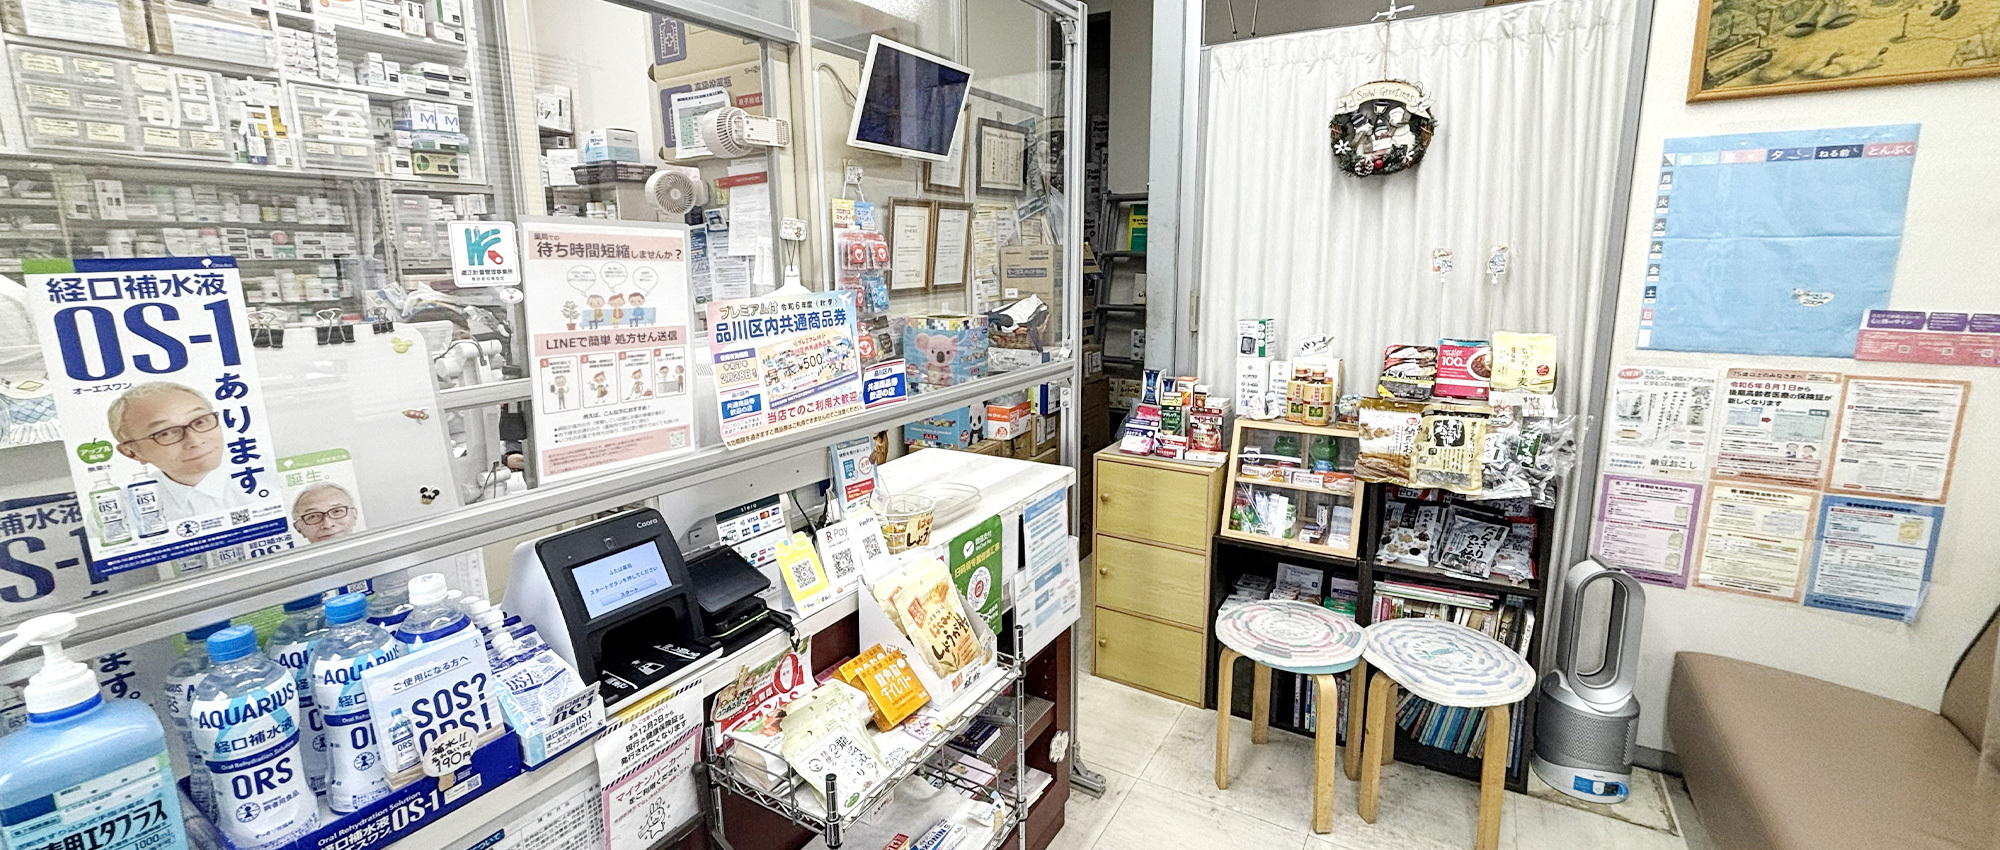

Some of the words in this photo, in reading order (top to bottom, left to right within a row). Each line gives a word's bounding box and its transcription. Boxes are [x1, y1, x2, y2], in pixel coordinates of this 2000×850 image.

[1380, 87, 1415, 101] Greetings
[1819, 149, 1849, 159] ねる前
[1661, 174, 1672, 184] 月
[1658, 198, 1668, 208] 火
[1655, 221, 1665, 230] 水
[533, 233, 559, 241] 薬局での
[536, 241, 682, 260] 待ち時間短縮しませんか?
[1652, 244, 1662, 253] 木
[1649, 267, 1659, 276] 金
[46, 272, 228, 303] 経口補水液
[1646, 288, 1656, 297] 土
[720, 301, 779, 319] プレミアム付
[715, 308, 847, 343] 品川区内共通商品券
[54, 298, 242, 381] OS-1
[546, 335, 611, 350] LINEで簡単
[615, 330, 678, 345] 処方せん送信
[874, 368, 893, 377] 品川区内
[1732, 371, 1803, 379] 75歳以上のみなさまへ
[72, 381, 132, 395] オーエスワン
[867, 378, 899, 391] 共通商品券
[1730, 381, 1812, 392] 令和6年8月1日から
[870, 389, 896, 400] 歓迎の店
[1727, 397, 1783, 407] 新しくなります
[1729, 389, 1832, 401] 後期高齢者医療の保険証が
[214, 373, 270, 498] あります。
[1650, 458, 1697, 469] 納豆おこし
[285, 469, 330, 487] 誕生。
[747, 515, 759, 523] VISA
[859, 517, 875, 527] PayPay
[834, 527, 848, 538] Pay
[250, 534, 292, 550] 経口補水液
[609, 563, 633, 575] ふたば薬局
[590, 566, 658, 596] スタートボタンを押してください
[620, 587, 639, 598] スタート
[100, 651, 141, 699] ます。
[392, 655, 470, 691] ご使用になる方へ
[874, 663, 901, 688] 龍角散
[200, 681, 296, 730] AQUARIUS
[411, 672, 488, 729] SOS?
[556, 690, 595, 714] 経口補水液
[215, 715, 294, 754] 経口補水液
[545, 722, 576, 742] 経口補水液
[576, 710, 592, 726] OS-1
[625, 713, 685, 753] 現行の健康保険証は
[628, 710, 675, 741] 本年12月2日から
[397, 740, 412, 752] ORS
[621, 720, 687, 765] 発行されなくなります
[231, 757, 294, 800] ORS
[616, 744, 692, 802] マイナンバーカード
[628, 763, 680, 805] をご利用ください
[317, 833, 338, 847] Oral
[338, 807, 389, 838] Rehydration
[389, 791, 421, 810] Solution
[391, 789, 440, 833] OS-1
[33, 800, 168, 850] 用エタプラス
